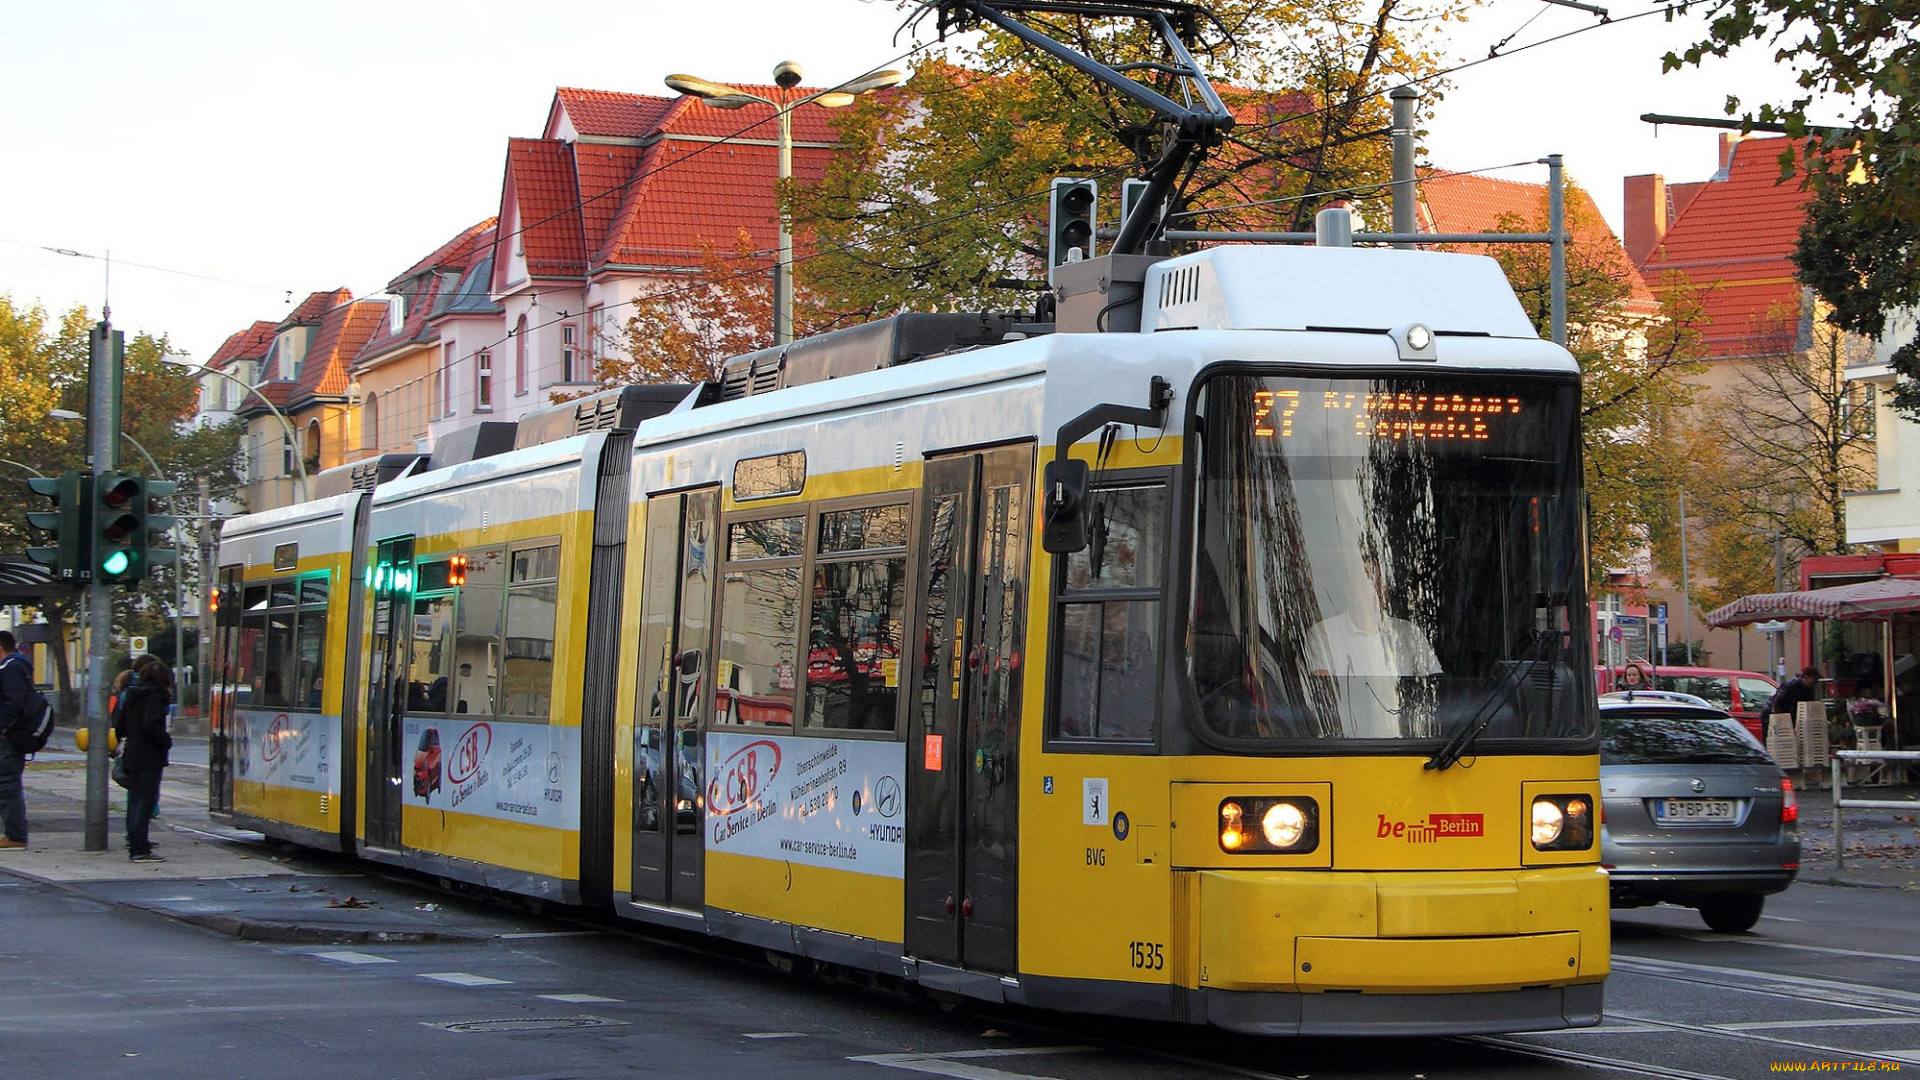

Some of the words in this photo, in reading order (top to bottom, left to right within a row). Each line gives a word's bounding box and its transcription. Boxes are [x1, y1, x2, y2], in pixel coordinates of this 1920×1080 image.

[459, 730, 478, 776] CSB
[726, 749, 758, 805] CSB
[838, 759, 847, 775] 89
[1706, 802, 1729, 816] 139
[714, 821, 726, 845] Car
[726, 816, 749, 838] Service
[757, 800, 776, 821] Berlin
[869, 823, 905, 843] HYUNDAI
[1440, 818, 1479, 833] Berlin
[780, 838, 857, 860] www.car-service-berlin.de
[1086, 848, 1106, 866] BVG
[1129, 940, 1164, 970] 1535
